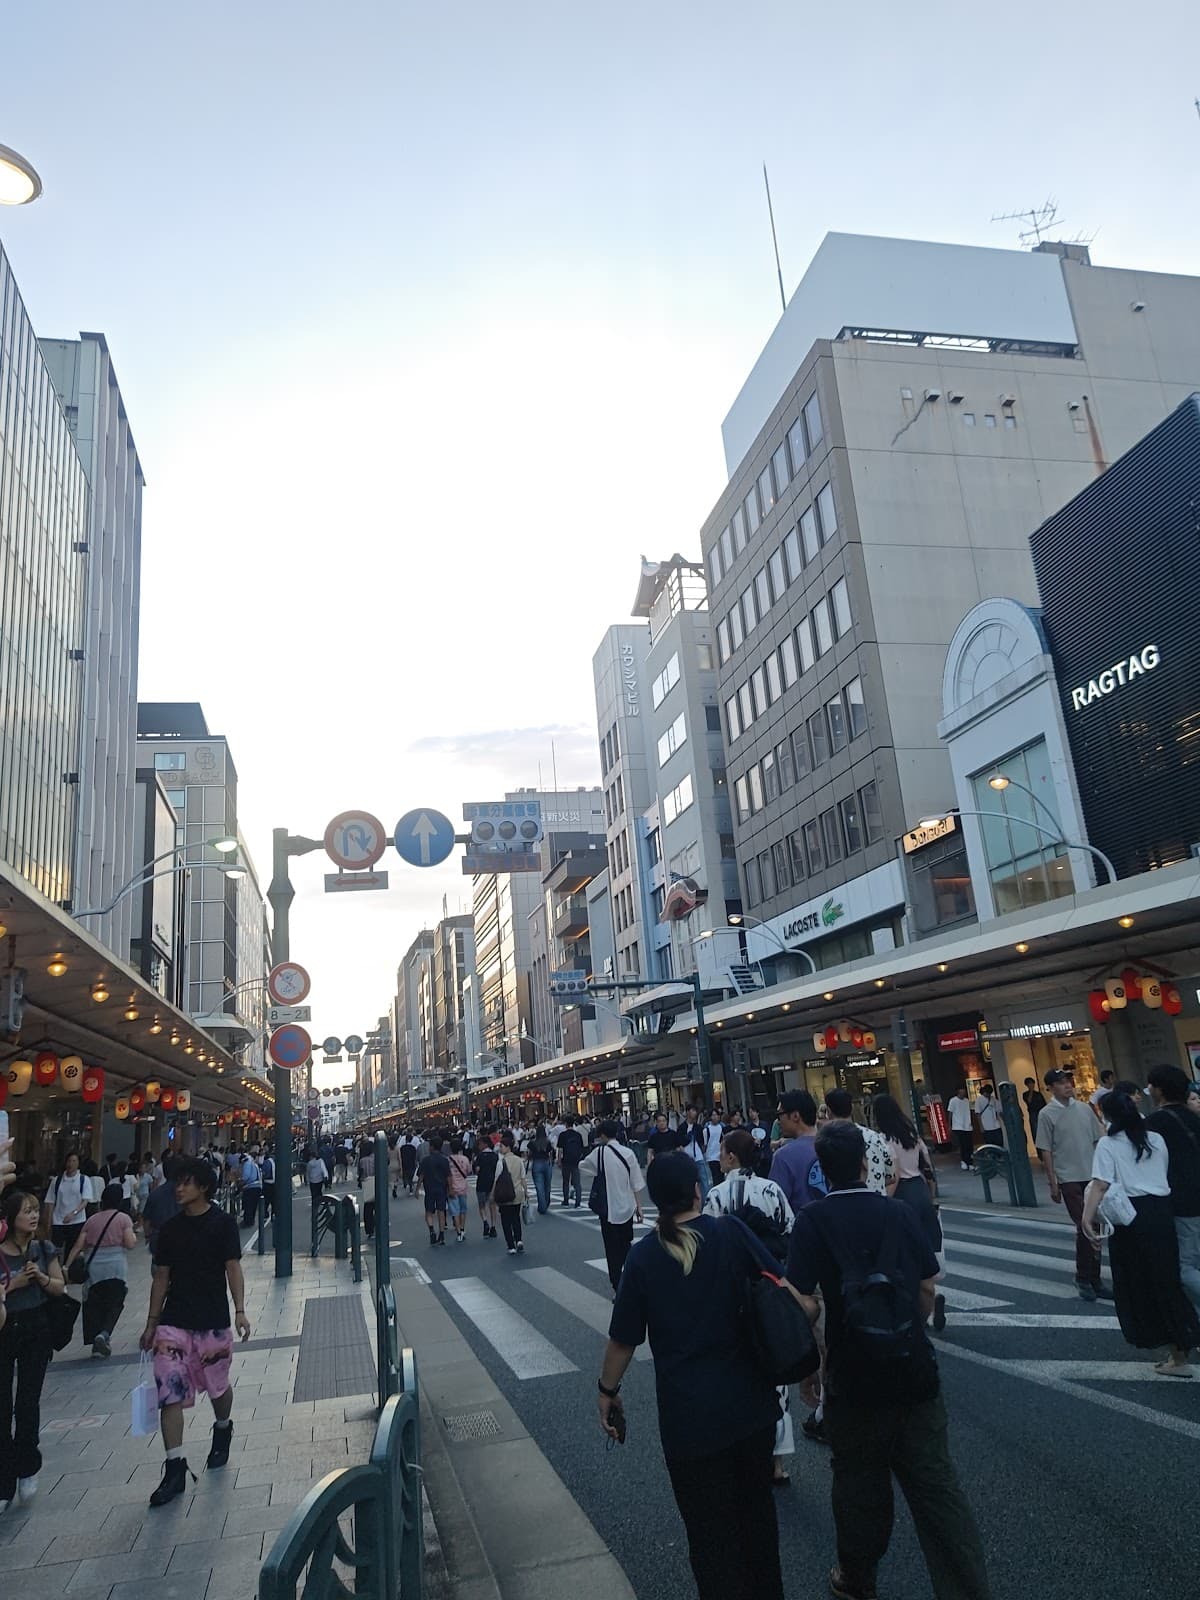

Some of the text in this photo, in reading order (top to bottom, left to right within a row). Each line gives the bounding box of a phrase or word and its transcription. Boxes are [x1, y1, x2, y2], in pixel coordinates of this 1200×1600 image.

[622, 644, 640, 716] カワシマビル
[1071, 643, 1160, 711] RAGTAG
[783, 911, 820, 940] LACOSTE
